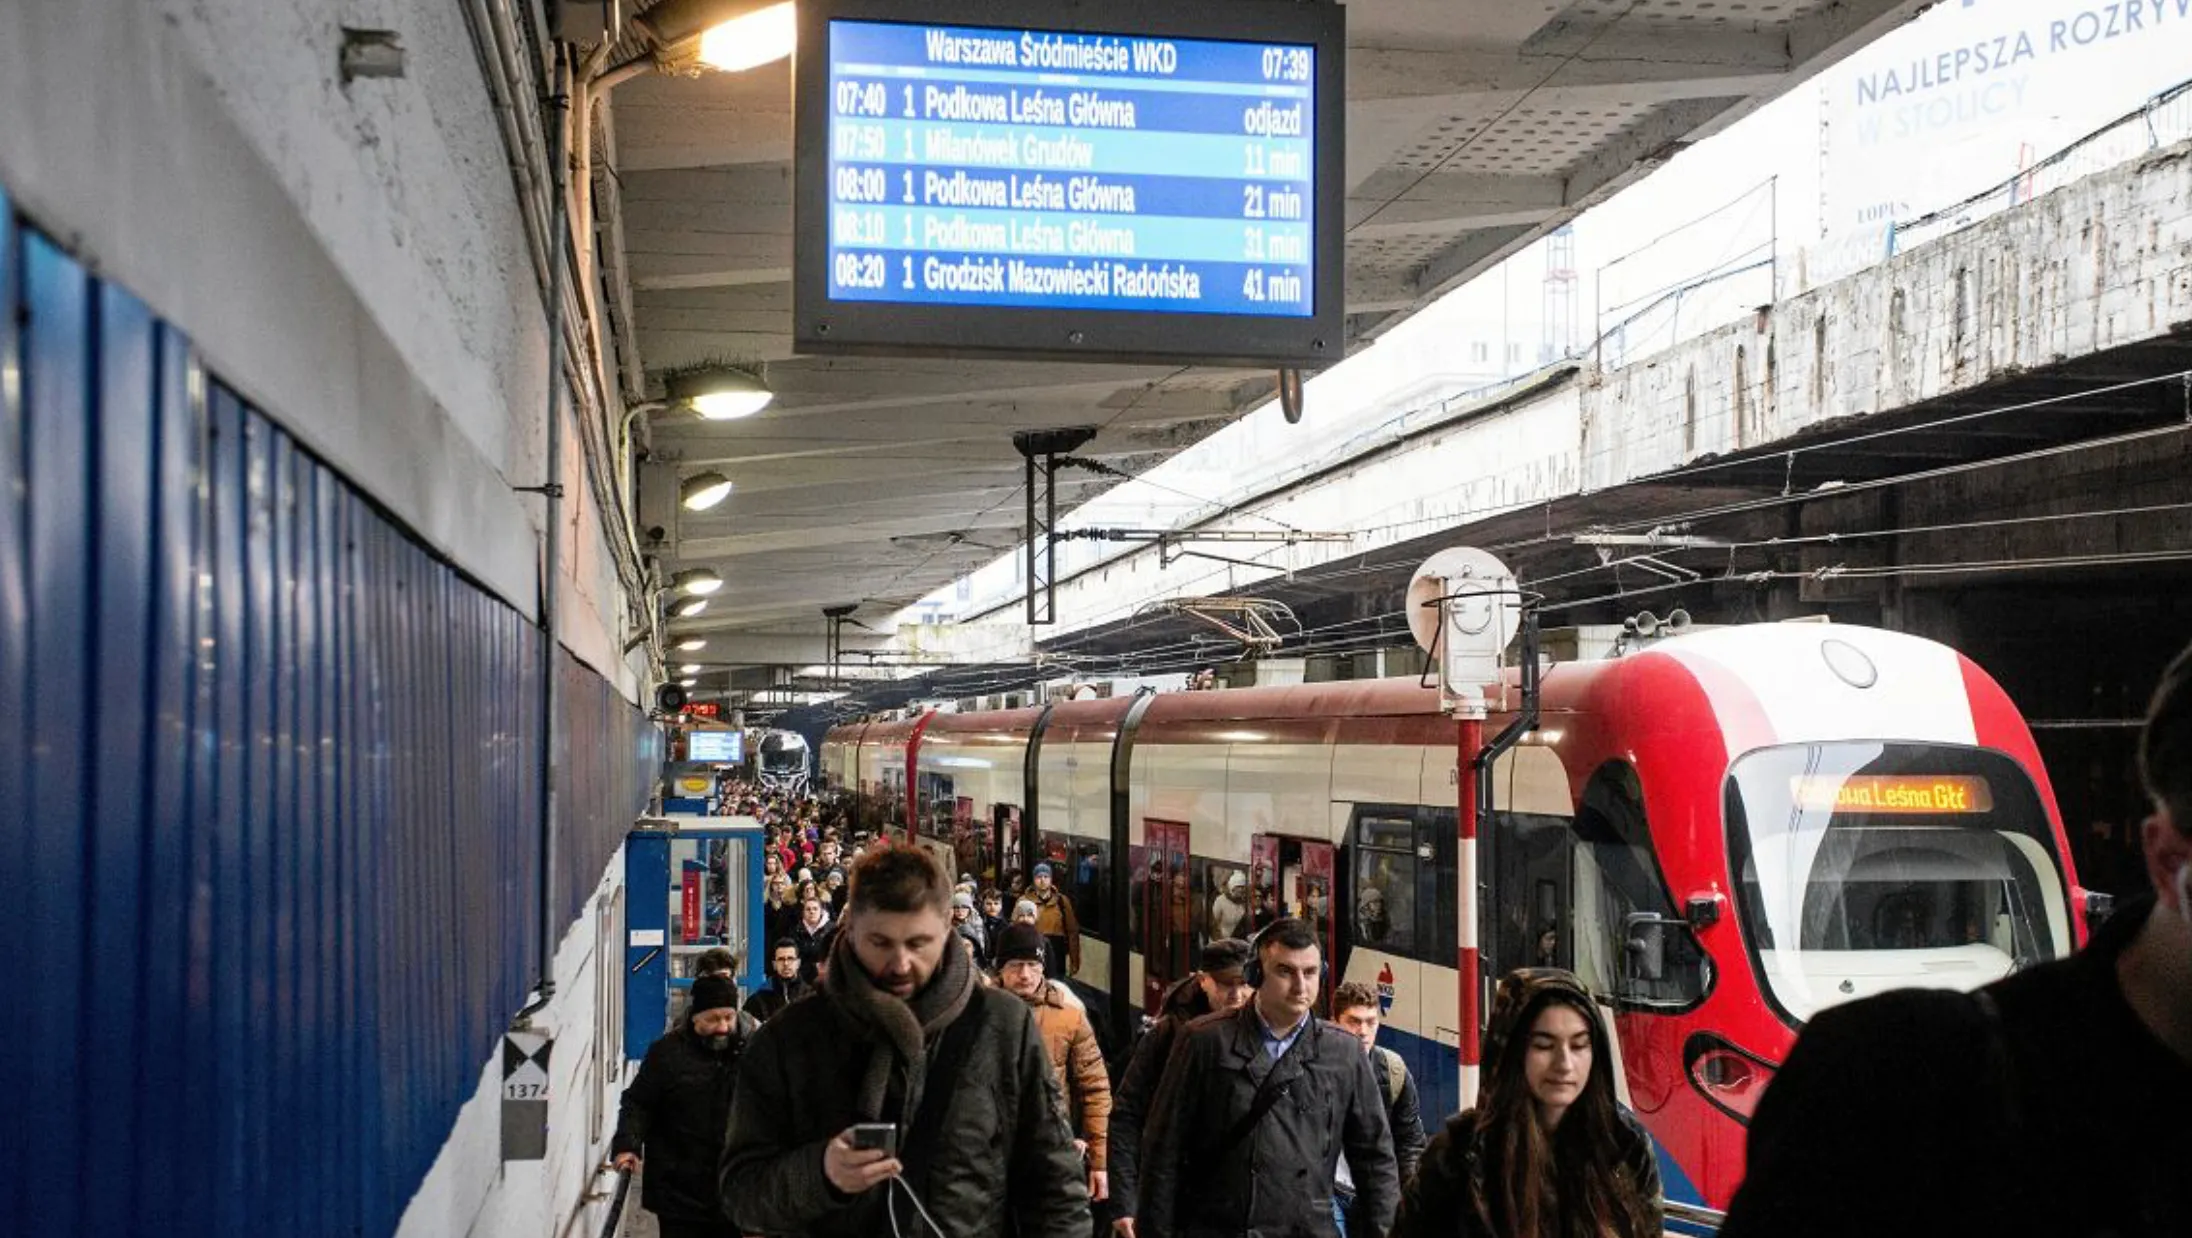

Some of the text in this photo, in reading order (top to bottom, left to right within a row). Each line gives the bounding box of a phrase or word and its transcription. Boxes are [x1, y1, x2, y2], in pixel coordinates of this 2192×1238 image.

[926, 29, 1308, 80] Warszawa Śródmieście WKD 07:39
[1857, 0, 2192, 106] NAJLEPSZA ROZRY
[837, 81, 1301, 138] 07:40 1 Podkowa Leśna Główna odjazd
[1857, 74, 2030, 147] W STOLICY
[836, 125, 1300, 178] 07:50 1 Milanówek Grudów 11 min
[837, 167, 1301, 219] 08:00 1 Podkowa Leśna Główna 21 min
[836, 210, 1300, 261] 08:10 1 Podkowa Leśna Główna 31 min
[836, 253, 1300, 302] 08:20 1 Grodzisk Mazowiecki Radońska 41 min
[1873, 780, 1932, 808] Leśna
